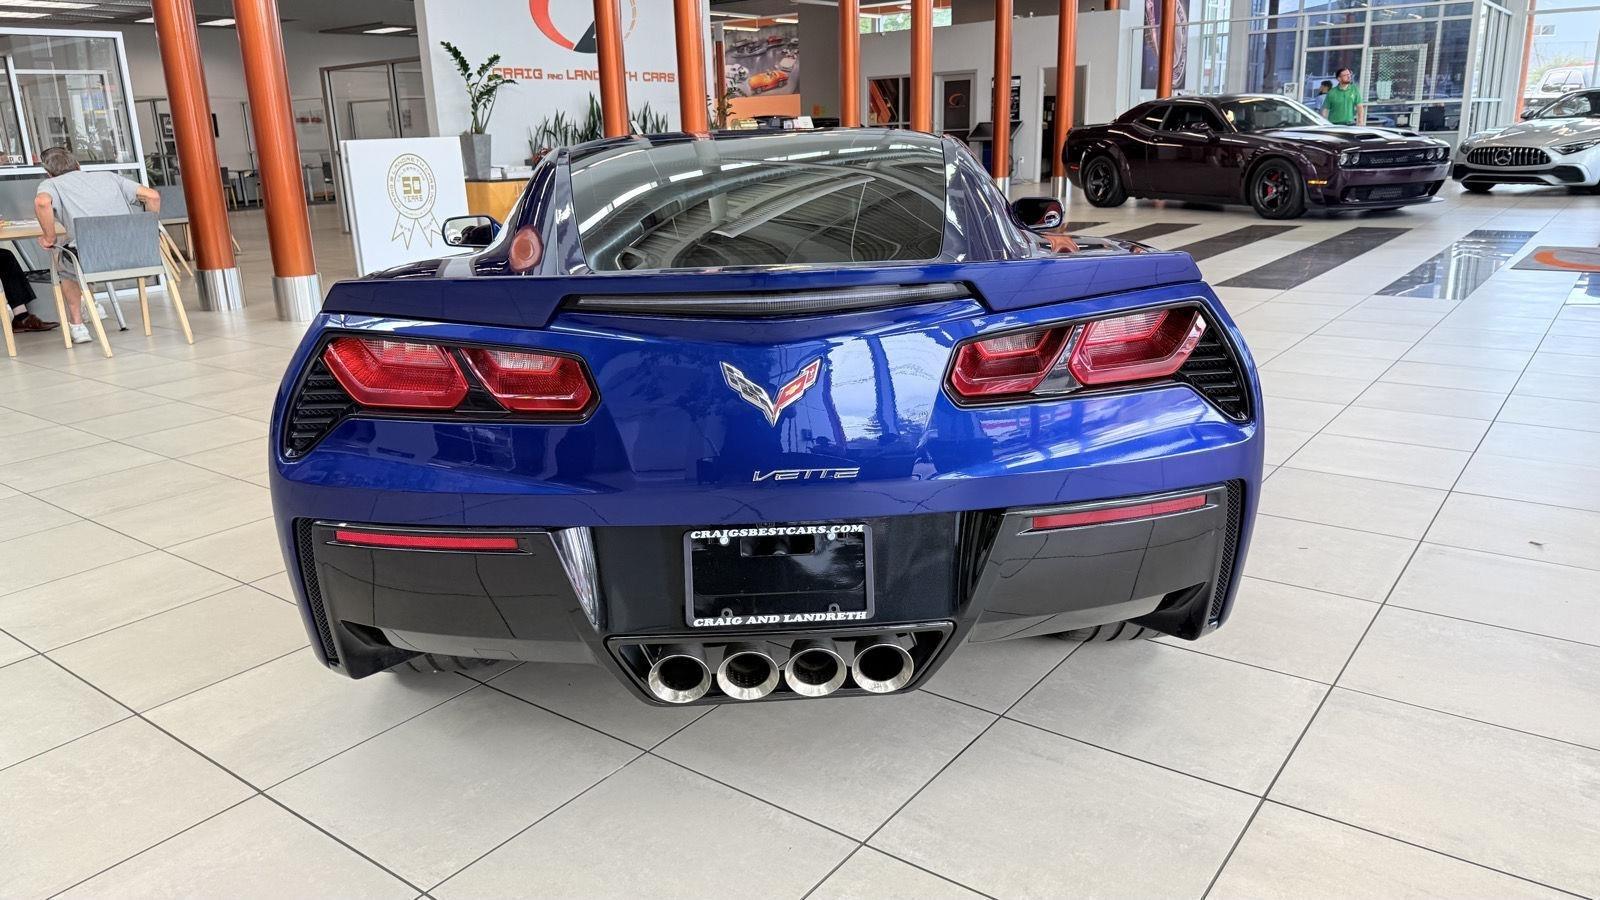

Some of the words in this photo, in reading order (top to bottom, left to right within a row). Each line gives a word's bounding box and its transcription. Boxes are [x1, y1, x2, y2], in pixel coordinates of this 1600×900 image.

[492, 67, 543, 80] CRAIG
[642, 72, 675, 83] CARS
[402, 176, 422, 195] 50
[404, 194, 423, 203] YEARS
[690, 524, 864, 540] CRAIGSBESTCARS.COM
[693, 616, 743, 627] CRAIG
[746, 615, 780, 625] AND
[783, 611, 867, 624] LANDRETH
